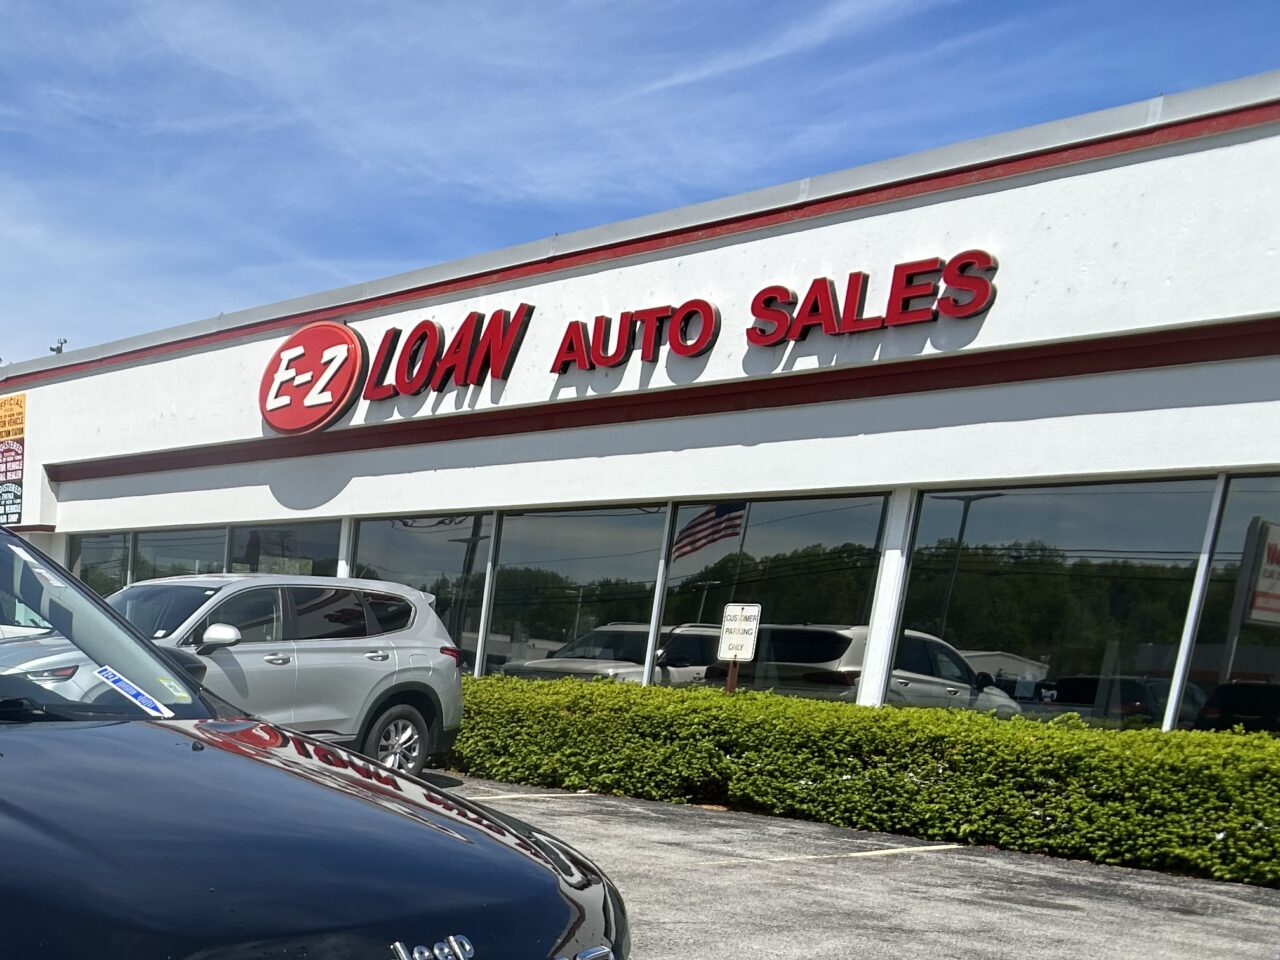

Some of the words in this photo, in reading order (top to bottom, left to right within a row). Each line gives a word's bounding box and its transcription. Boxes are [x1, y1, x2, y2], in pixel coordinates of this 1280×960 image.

[266, 343, 349, 411] E-Z
[363, 303, 535, 400] LOAN
[550, 299, 720, 374] AUTO
[746, 249, 998, 347] SALES
[7, 416, 24, 427] VEHICLE
[10, 427, 23, 436] STATION
[6, 460, 23, 470] VEHICLE
[5, 504, 21, 513] VEHICLE
[7, 513, 19, 522] SHOP
